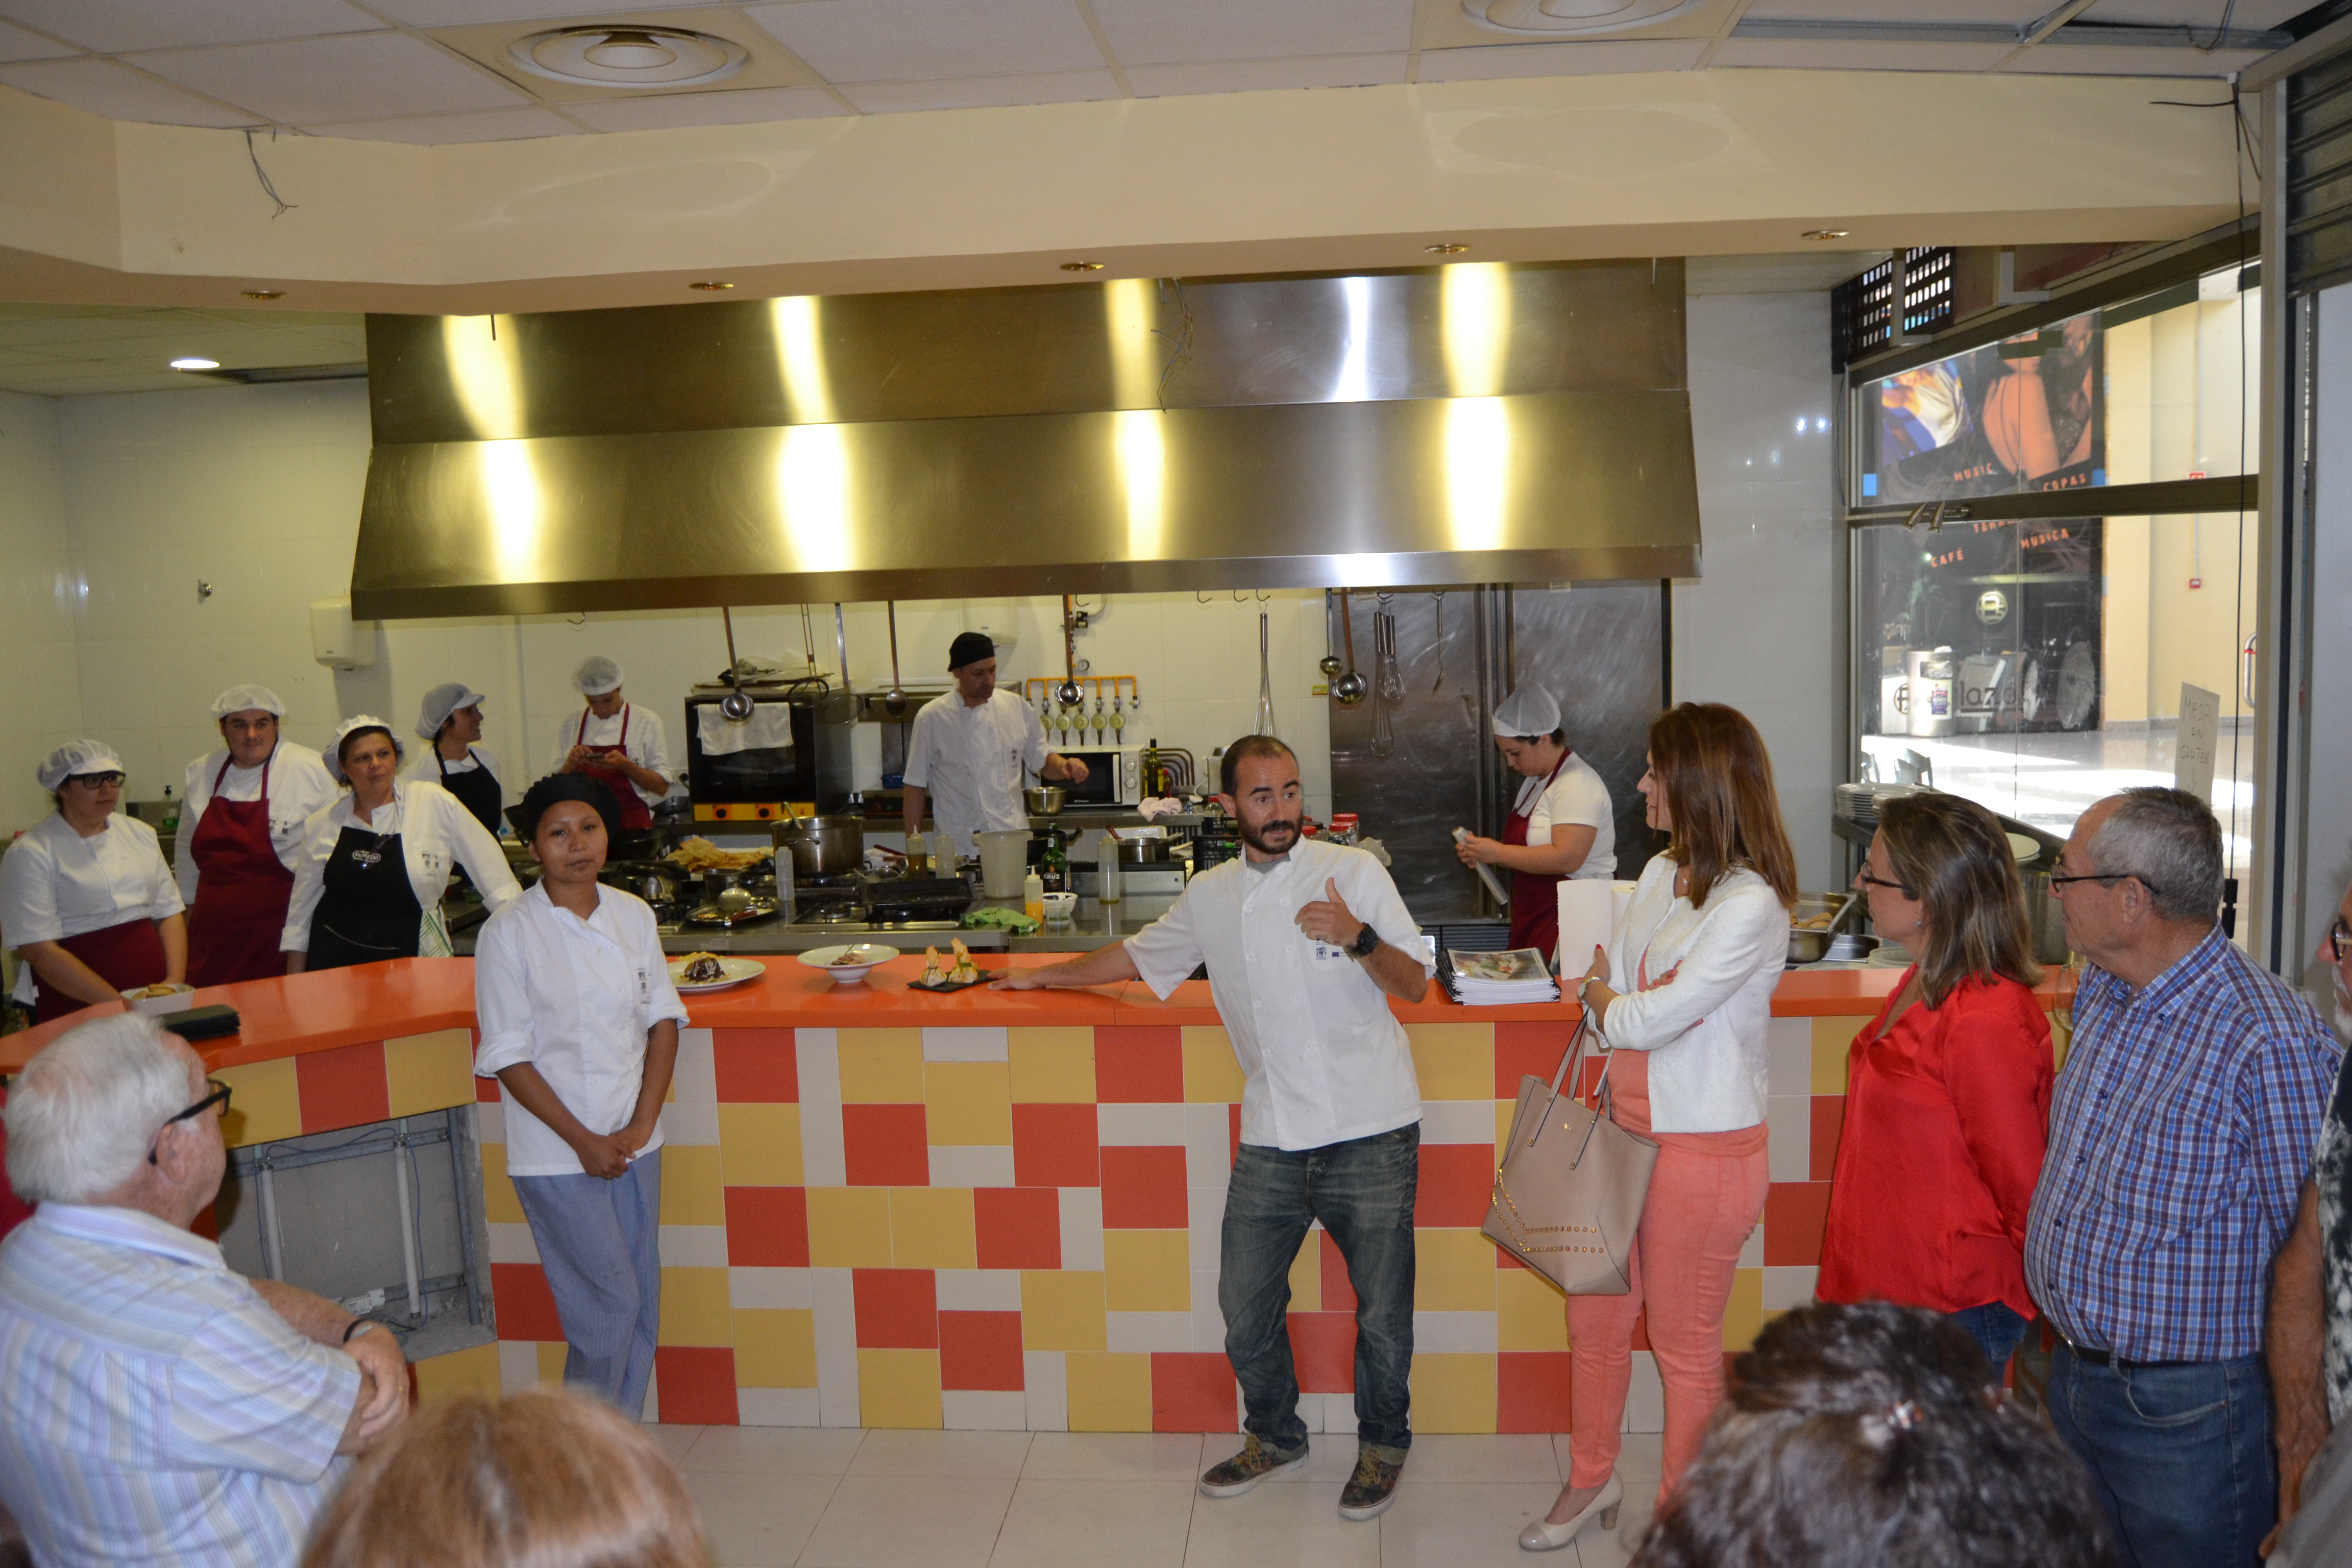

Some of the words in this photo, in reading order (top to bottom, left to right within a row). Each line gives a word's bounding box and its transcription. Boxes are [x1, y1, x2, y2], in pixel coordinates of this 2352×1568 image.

[1953, 462, 1993, 482] MUSIC
[2043, 473, 2087, 492] COPAS
[2020, 528, 2070, 550] MÚSICA
[1931, 547, 1964, 568] CAFÉ
